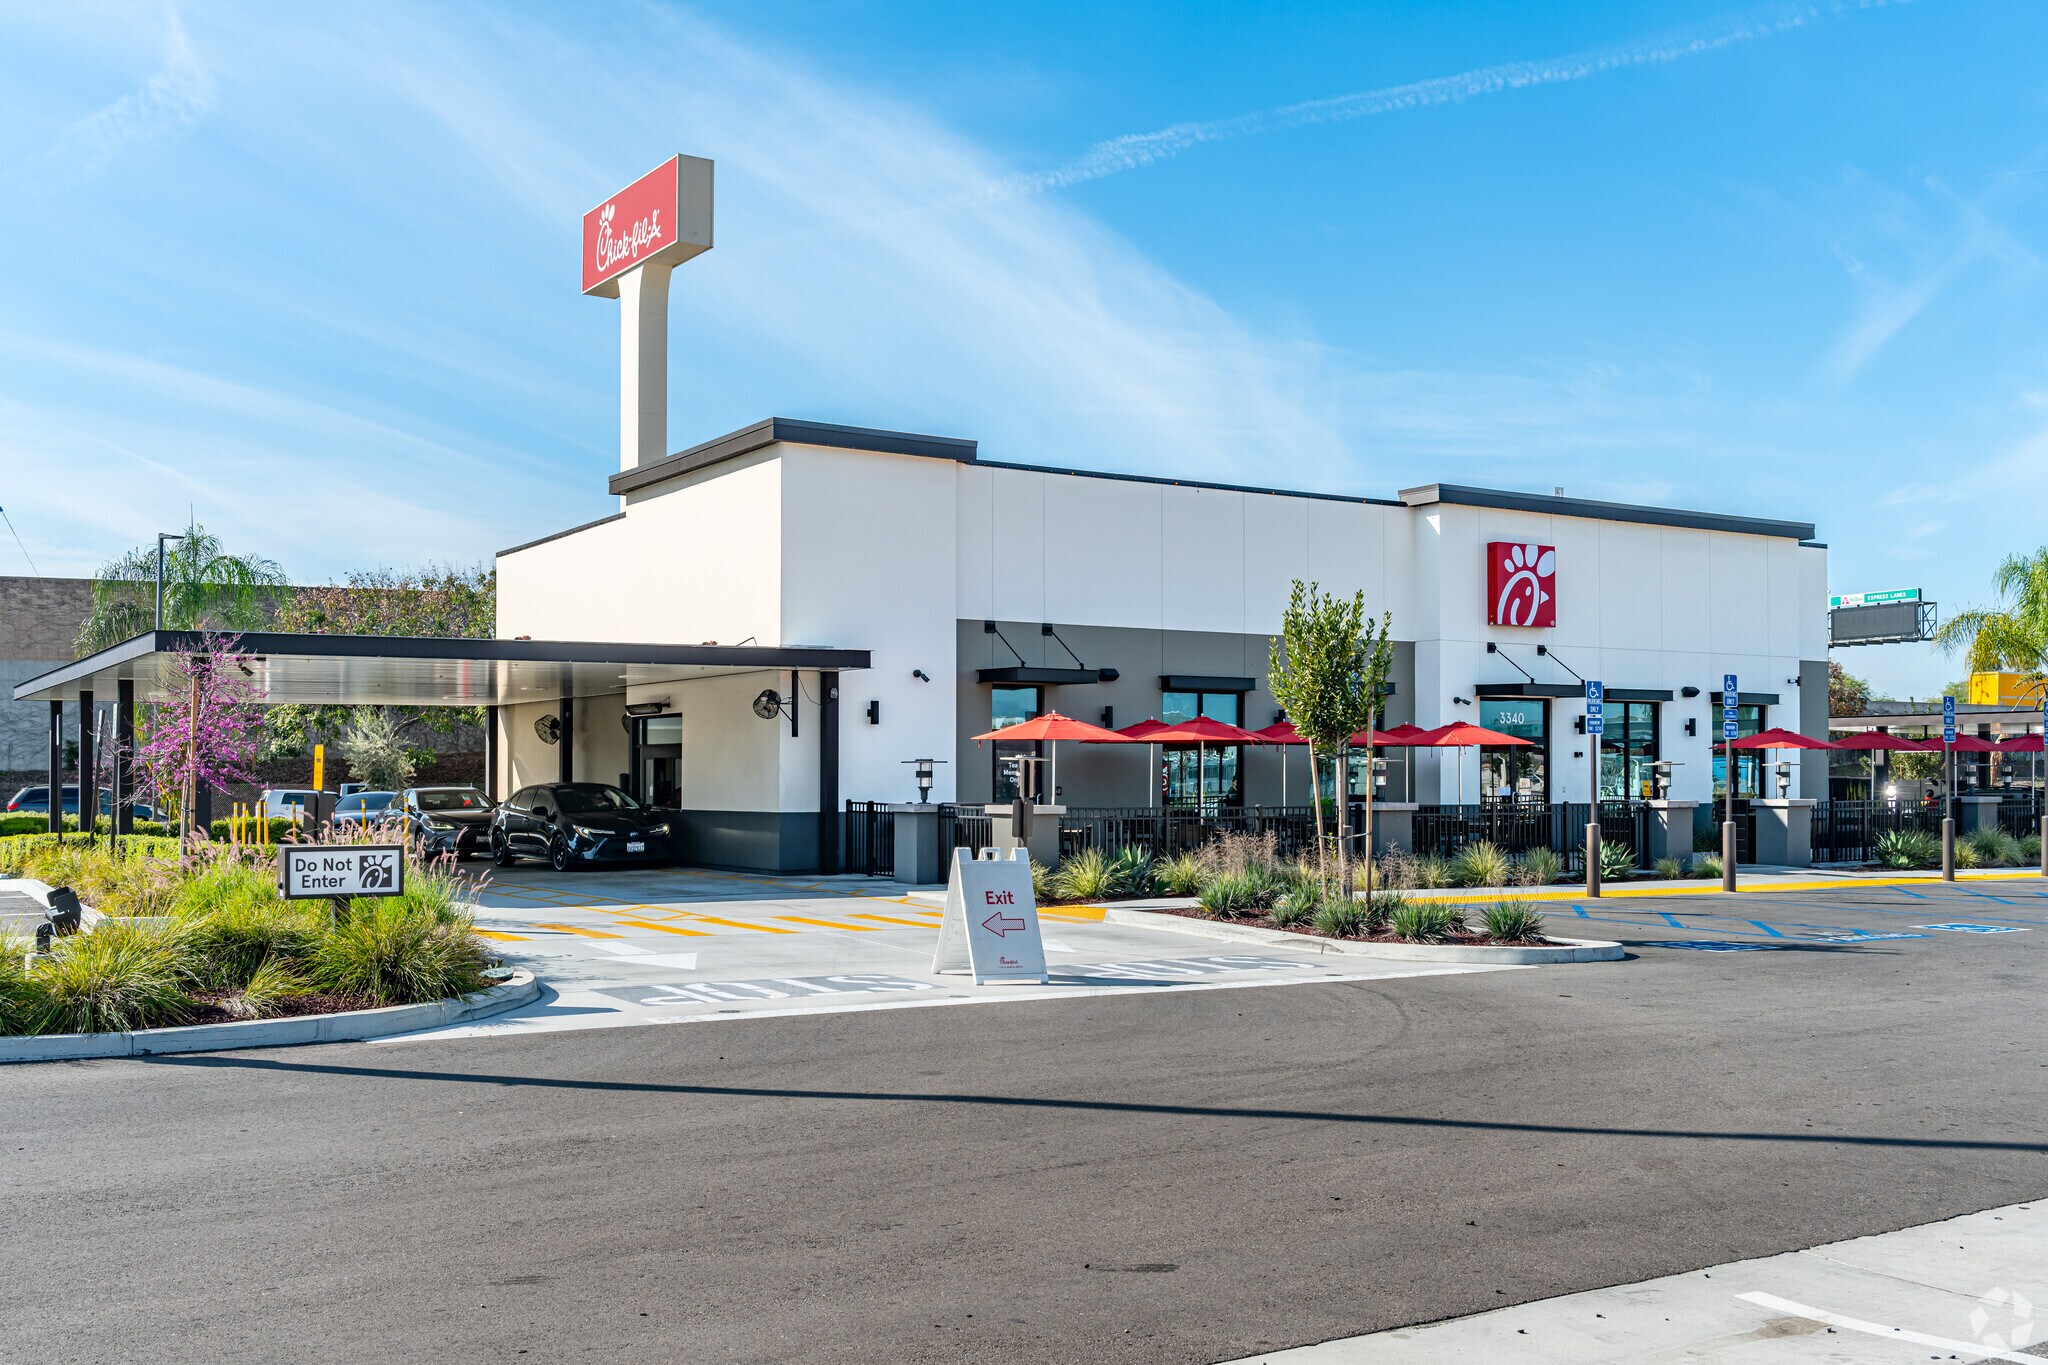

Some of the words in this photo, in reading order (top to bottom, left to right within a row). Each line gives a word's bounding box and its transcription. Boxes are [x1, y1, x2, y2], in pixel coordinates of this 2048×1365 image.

[596, 204, 661, 272] Chick-fil-A
[1499, 712, 1525, 724] 3340
[295, 858, 318, 872] Do
[323, 857, 352, 872] Not
[301, 874, 346, 888] Enter
[985, 890, 1015, 905] Exit
[1072, 956, 1315, 977] STOP
[640, 974, 934, 1005] STOP
